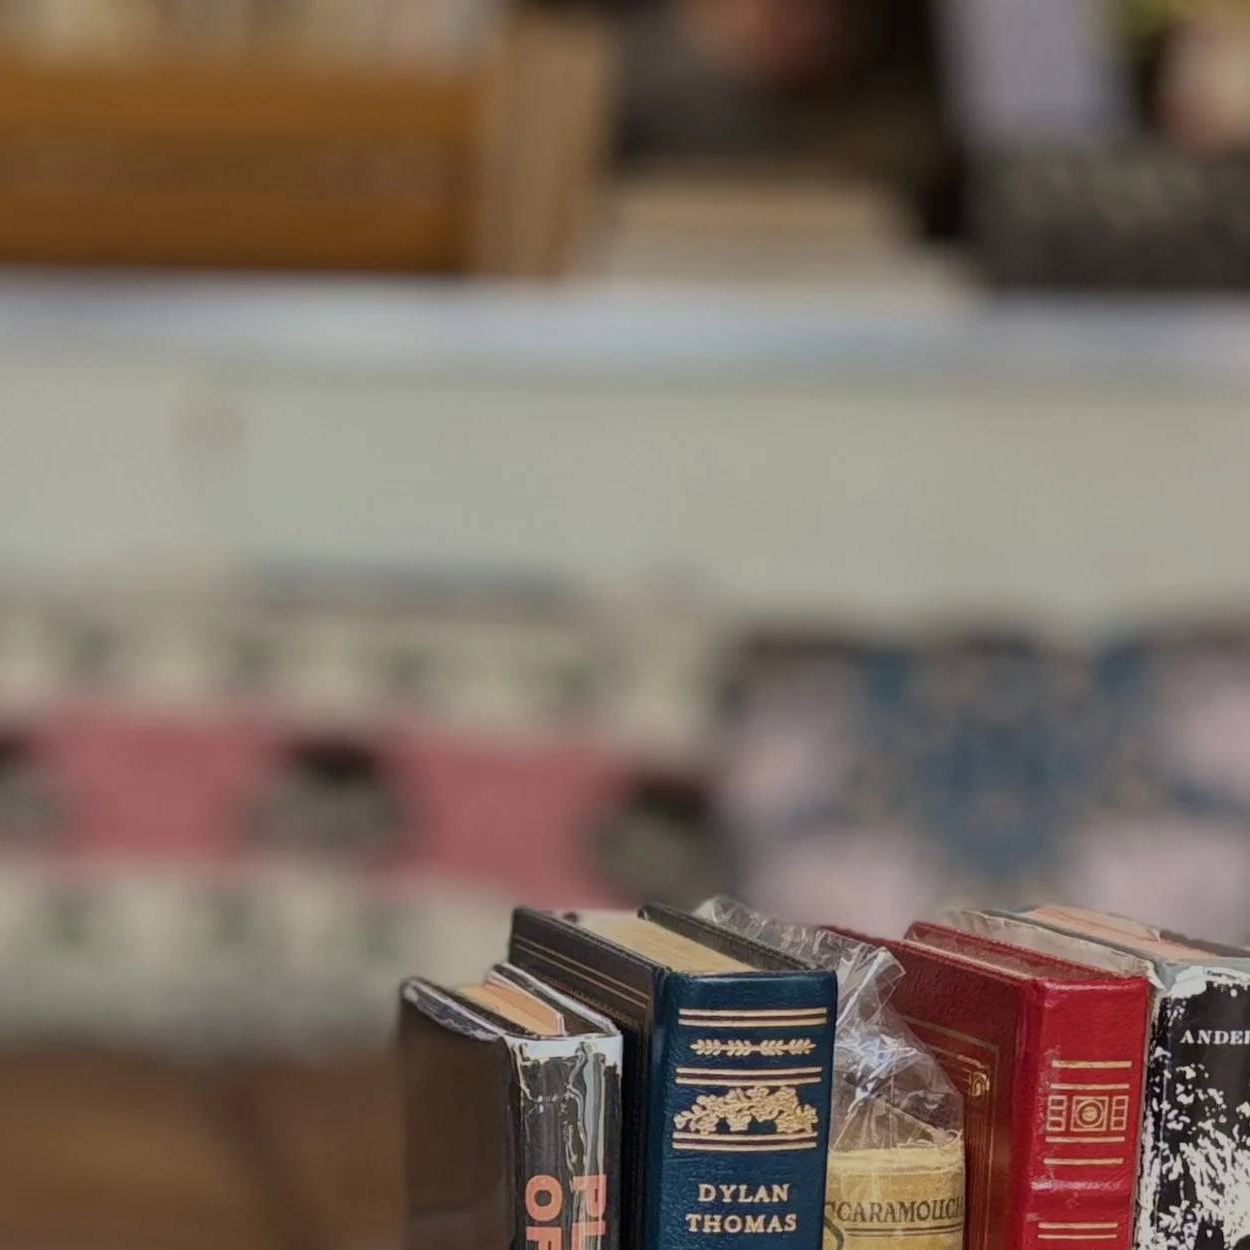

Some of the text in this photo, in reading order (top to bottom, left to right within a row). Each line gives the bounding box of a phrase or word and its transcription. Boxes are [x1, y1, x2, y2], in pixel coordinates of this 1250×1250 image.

[1179, 1029, 1250, 1045] ANDE
[698, 1183, 791, 1203] DYLAN
[685, 1213, 797, 1233] THOMAS
